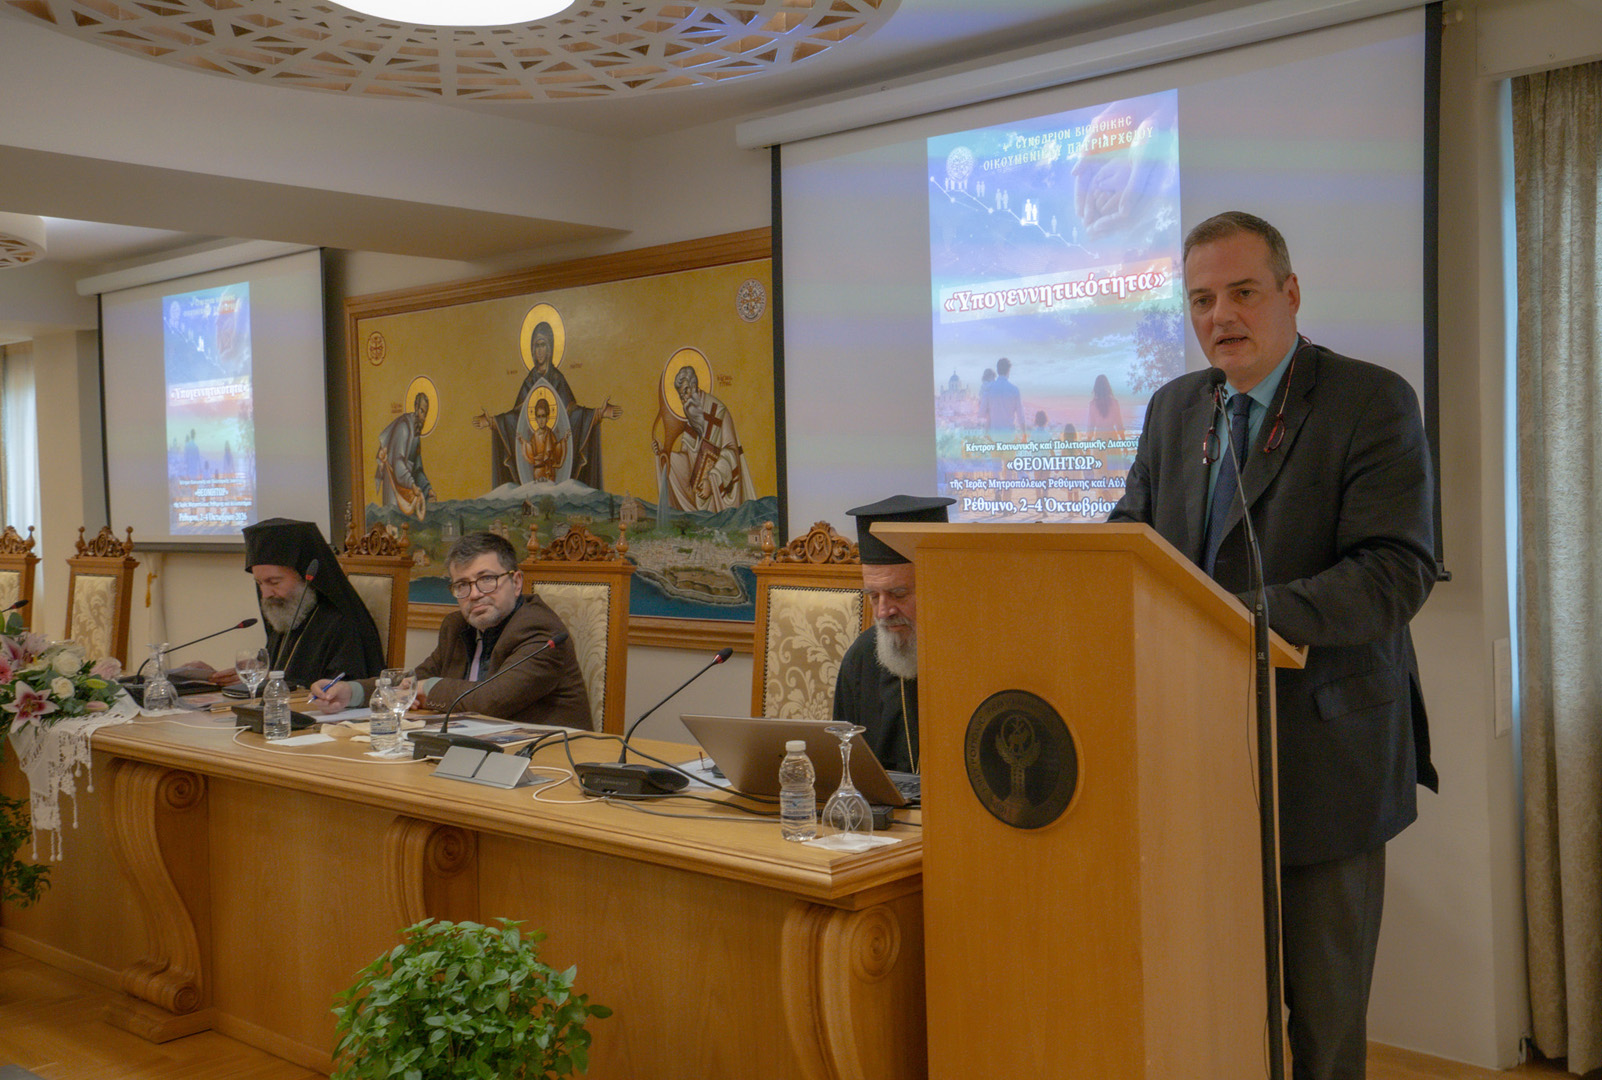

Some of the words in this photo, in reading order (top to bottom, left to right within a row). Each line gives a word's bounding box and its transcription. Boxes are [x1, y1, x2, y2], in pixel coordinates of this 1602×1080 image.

[1107, 438, 1139, 449] Διακονί
[1006, 456, 1103, 471] «ΘΕΟΜΗΤΩΡ»
[988, 478, 1047, 491] Μητροπόλεως
[963, 497, 1018, 516] Ρέθυμνο,
